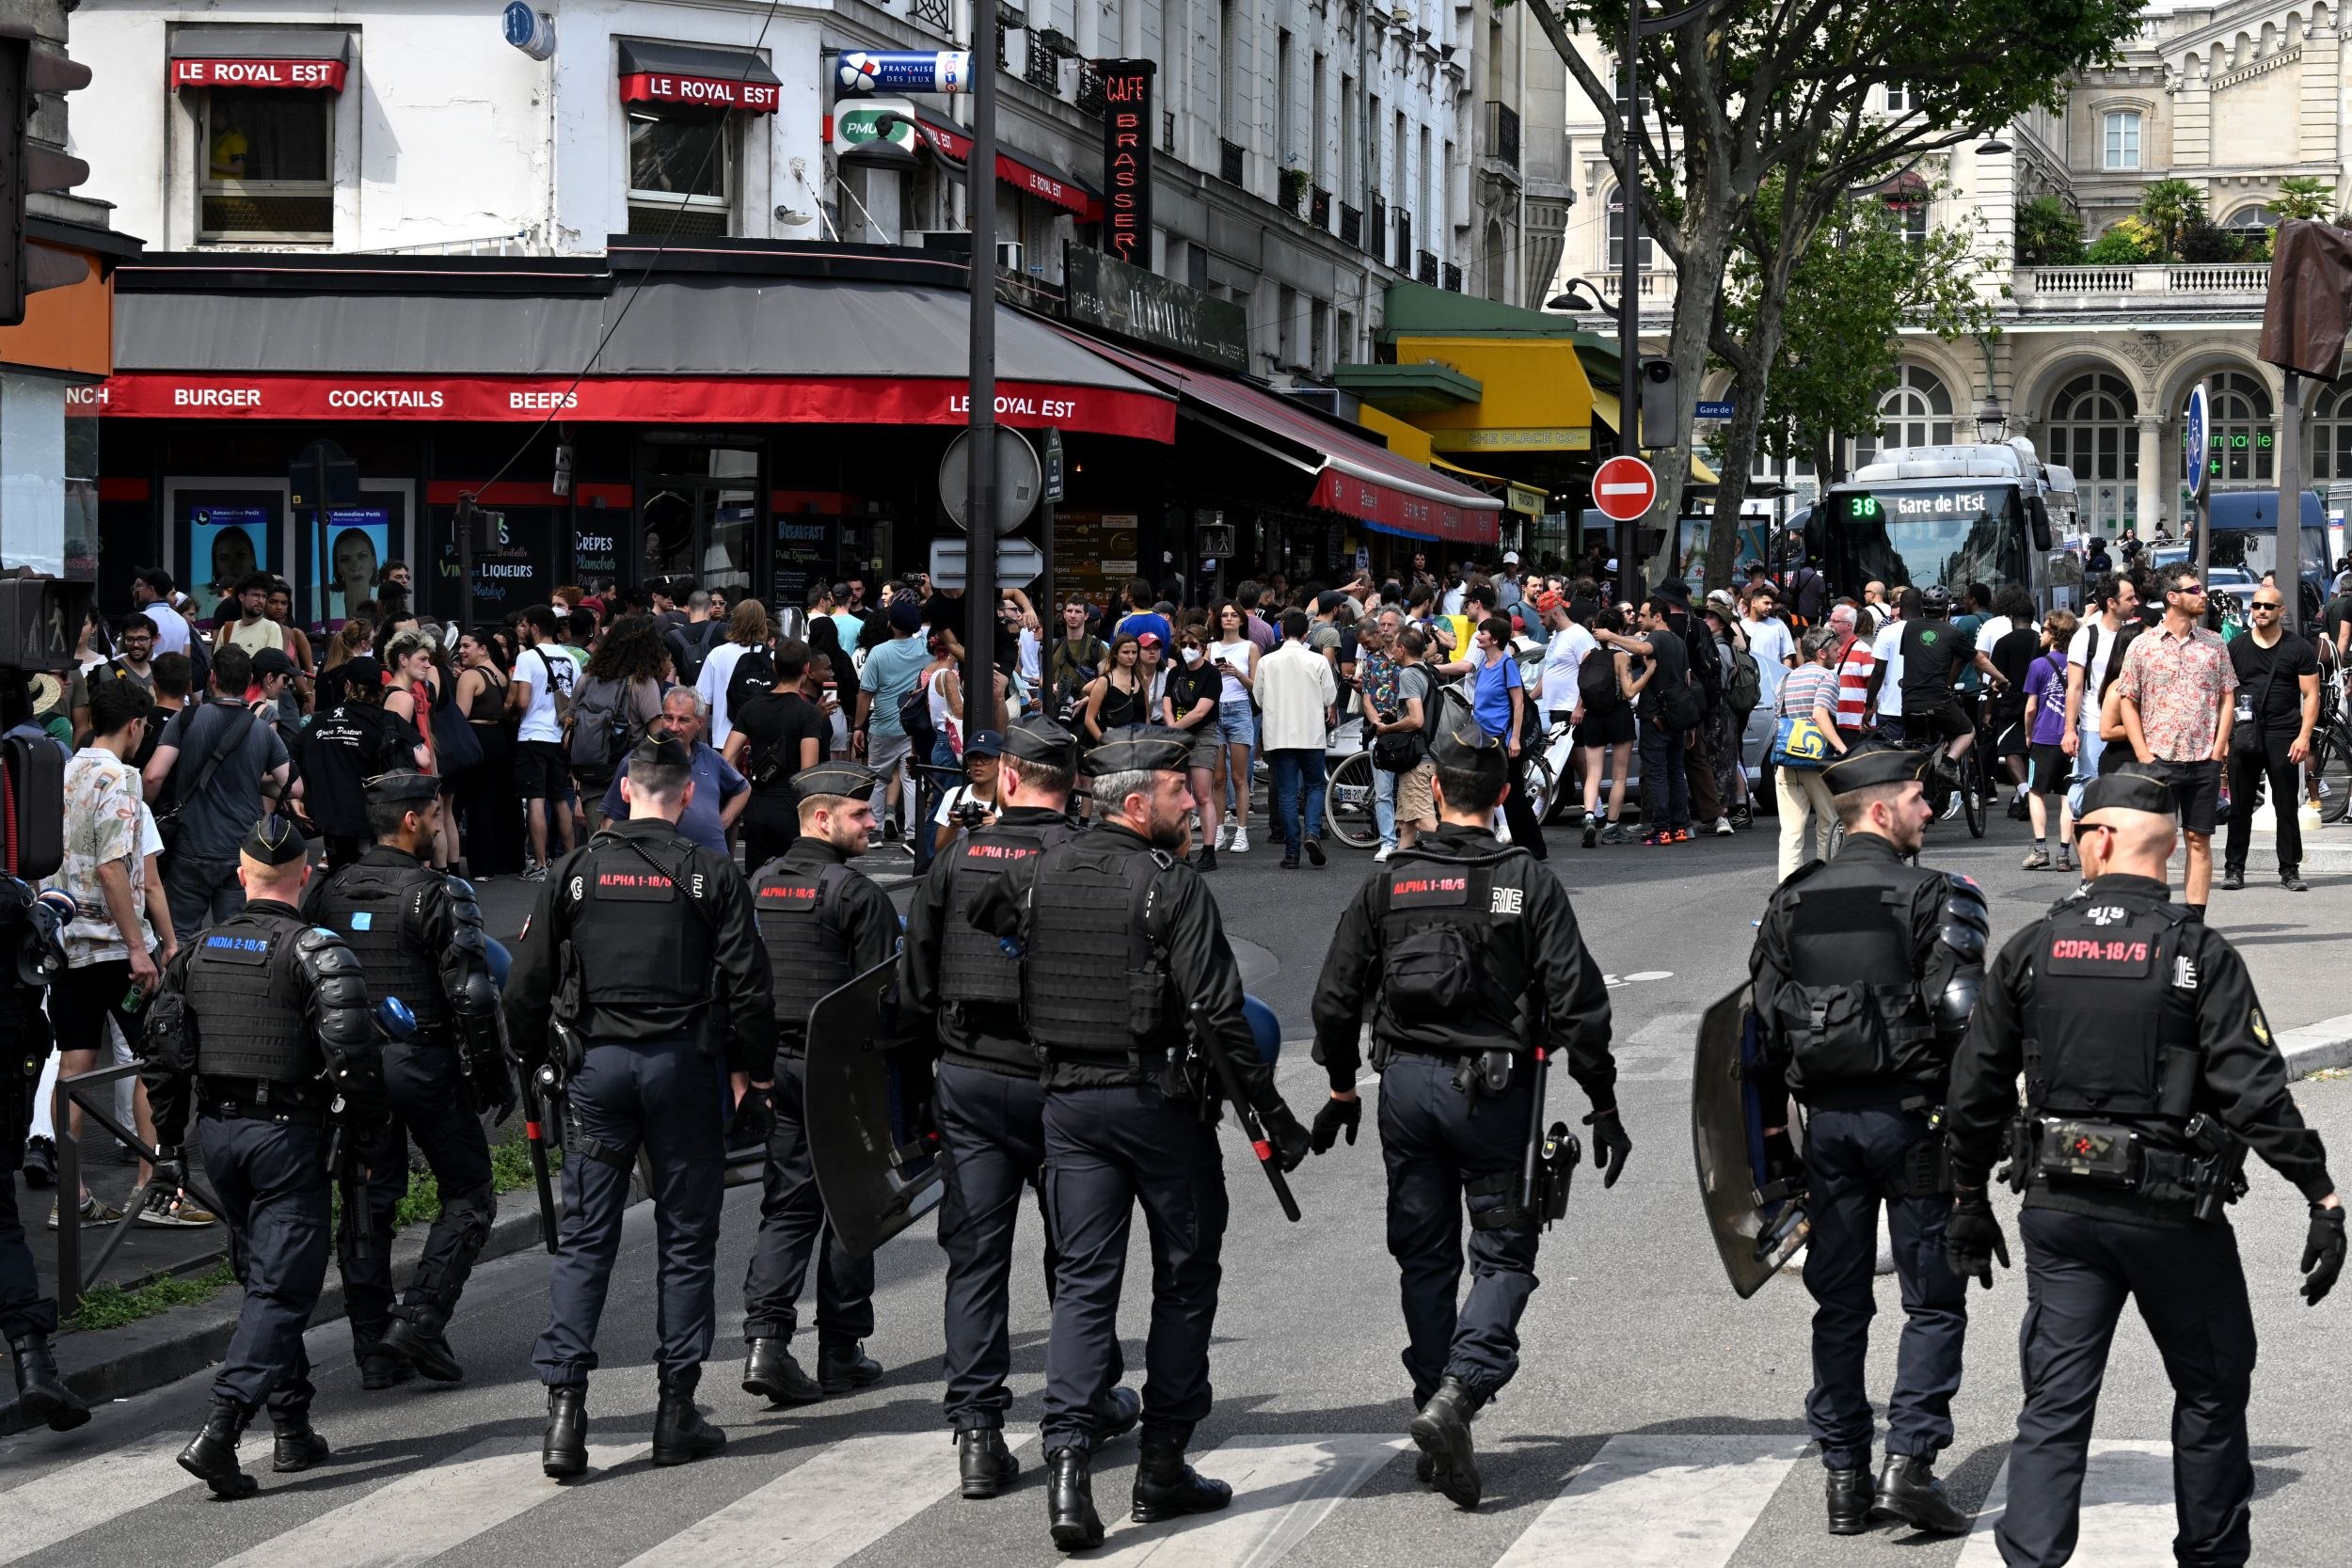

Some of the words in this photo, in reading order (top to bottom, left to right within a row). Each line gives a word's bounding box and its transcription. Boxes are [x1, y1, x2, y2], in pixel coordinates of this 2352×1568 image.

[180, 64, 203, 79] LE
[215, 64, 281, 81] ROYAL
[292, 66, 330, 81] EST
[882, 65, 934, 74] FRANÇAISE
[650, 78, 672, 95] LE
[680, 81, 735, 101] ROYAL
[744, 87, 775, 103] EST
[847, 122, 877, 135] PMU
[1029, 174, 1036, 188] LE
[1037, 177, 1052, 195] ROYAL
[1053, 182, 1062, 198] EST
[174, 388, 262, 406] BURGER
[328, 390, 444, 408] COCKTAILS
[509, 391, 578, 409] BEERS
[993, 396, 1037, 415] OYAL
[1041, 400, 1075, 418] EST
[1700, 405, 1718, 414] Gare
[1502, 433, 1551, 444] PLACE
[1852, 498, 1876, 516] 38
[1898, 497, 1931, 514] Gare
[1935, 495, 1952, 513] de
[1956, 493, 1986, 512] l'Est
[778, 520, 826, 541] BREAKFAST
[482, 562, 533, 578] LIQUEURS
[1053, 566, 1071, 575] rêpes
[968, 846, 1002, 858] ALPHA
[599, 874, 636, 886] ALPHA
[638, 876, 673, 888] 1-18/5
[1393, 879, 1428, 894] ALPHA
[1430, 878, 1466, 892] 1-18/5
[760, 887, 787, 898] ALPHA
[787, 888, 815, 899] 1-18/5
[207, 936, 233, 949] INDIA
[234, 938, 268, 952] 2-18/5
